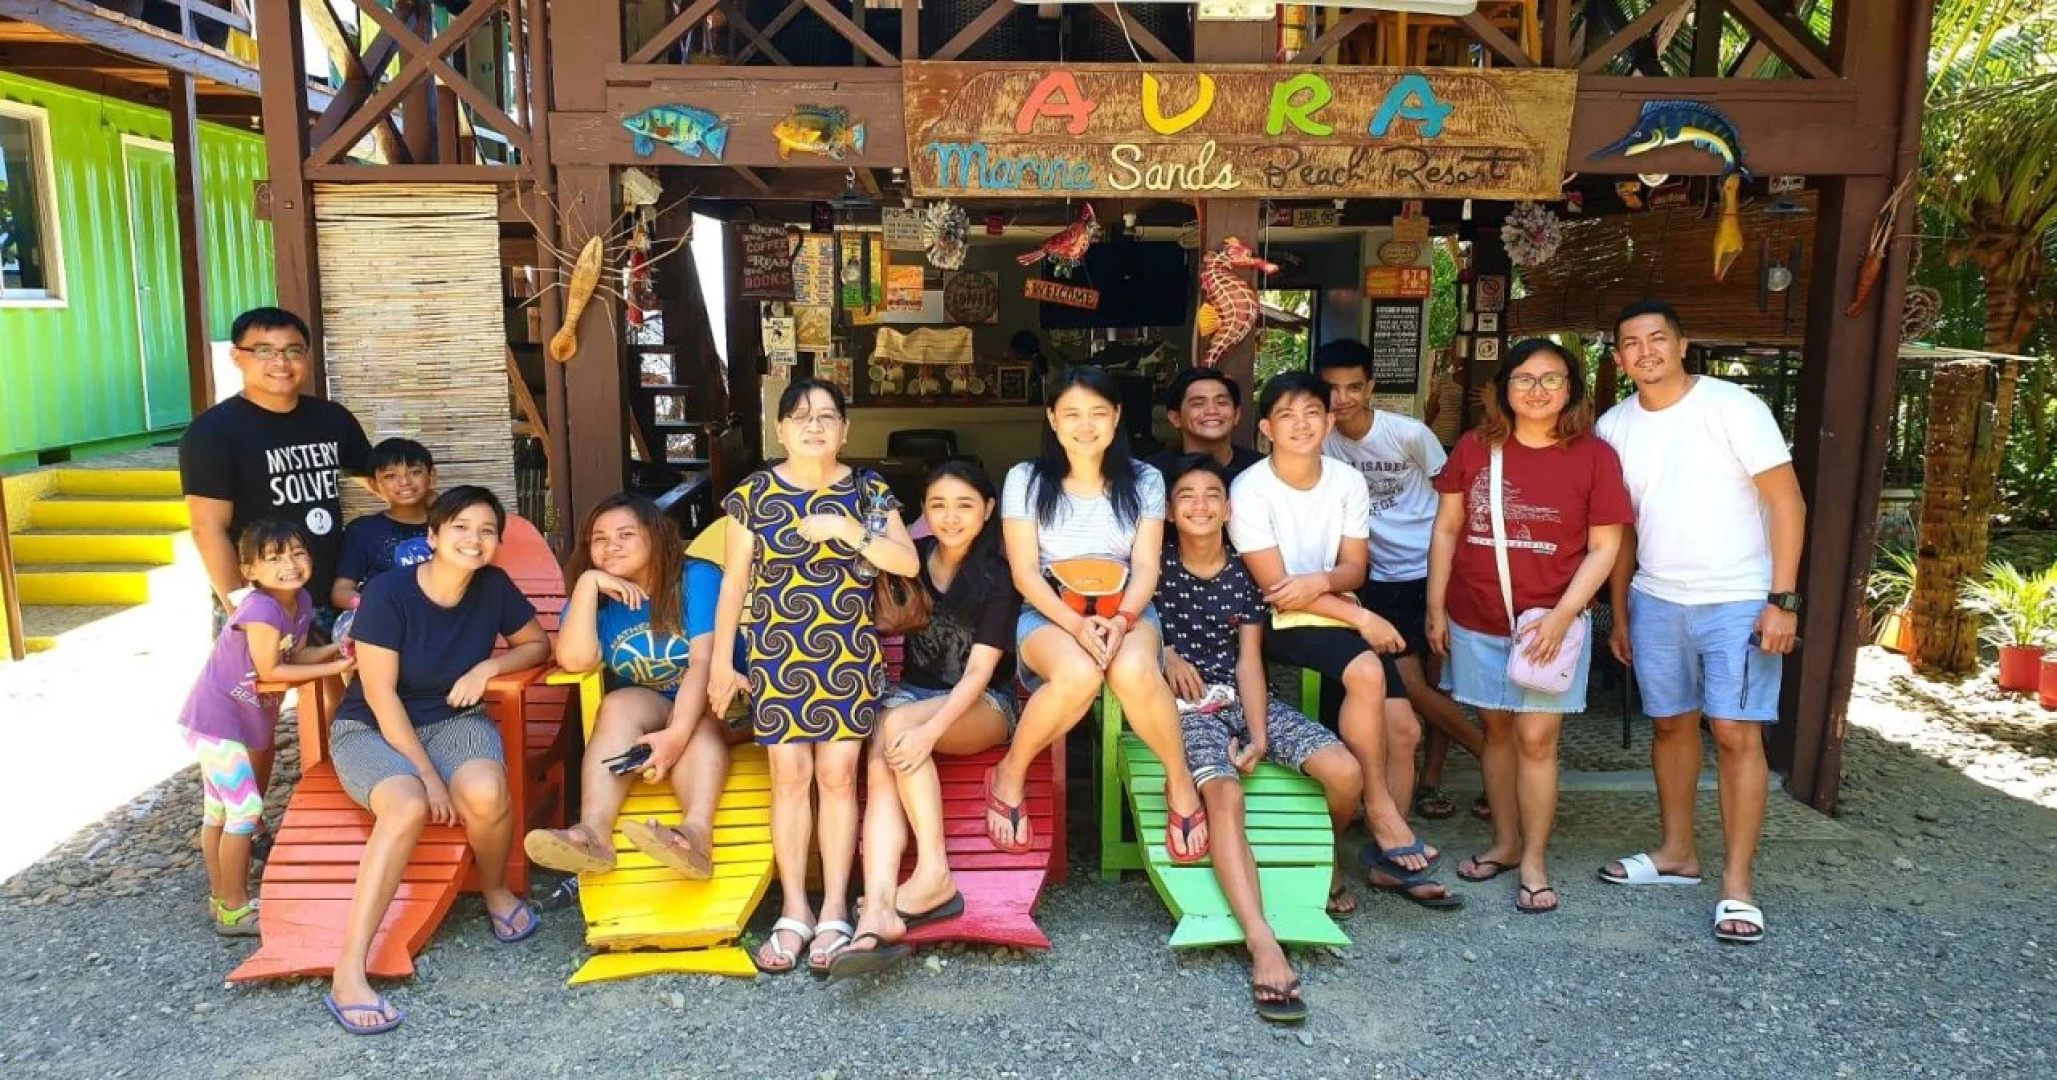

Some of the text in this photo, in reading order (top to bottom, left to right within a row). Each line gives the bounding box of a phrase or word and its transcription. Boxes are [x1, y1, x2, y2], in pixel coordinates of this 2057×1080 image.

[1015, 71, 1454, 137] AURA
[927, 140, 1520, 191] Marina Sands Beach Resort
[746, 238, 788, 253] COFFEE
[745, 271, 790, 289] BOOKS
[1032, 281, 1095, 307] WELCOME
[265, 441, 339, 474] MYSTERY
[1360, 460, 1410, 472] ISABEL
